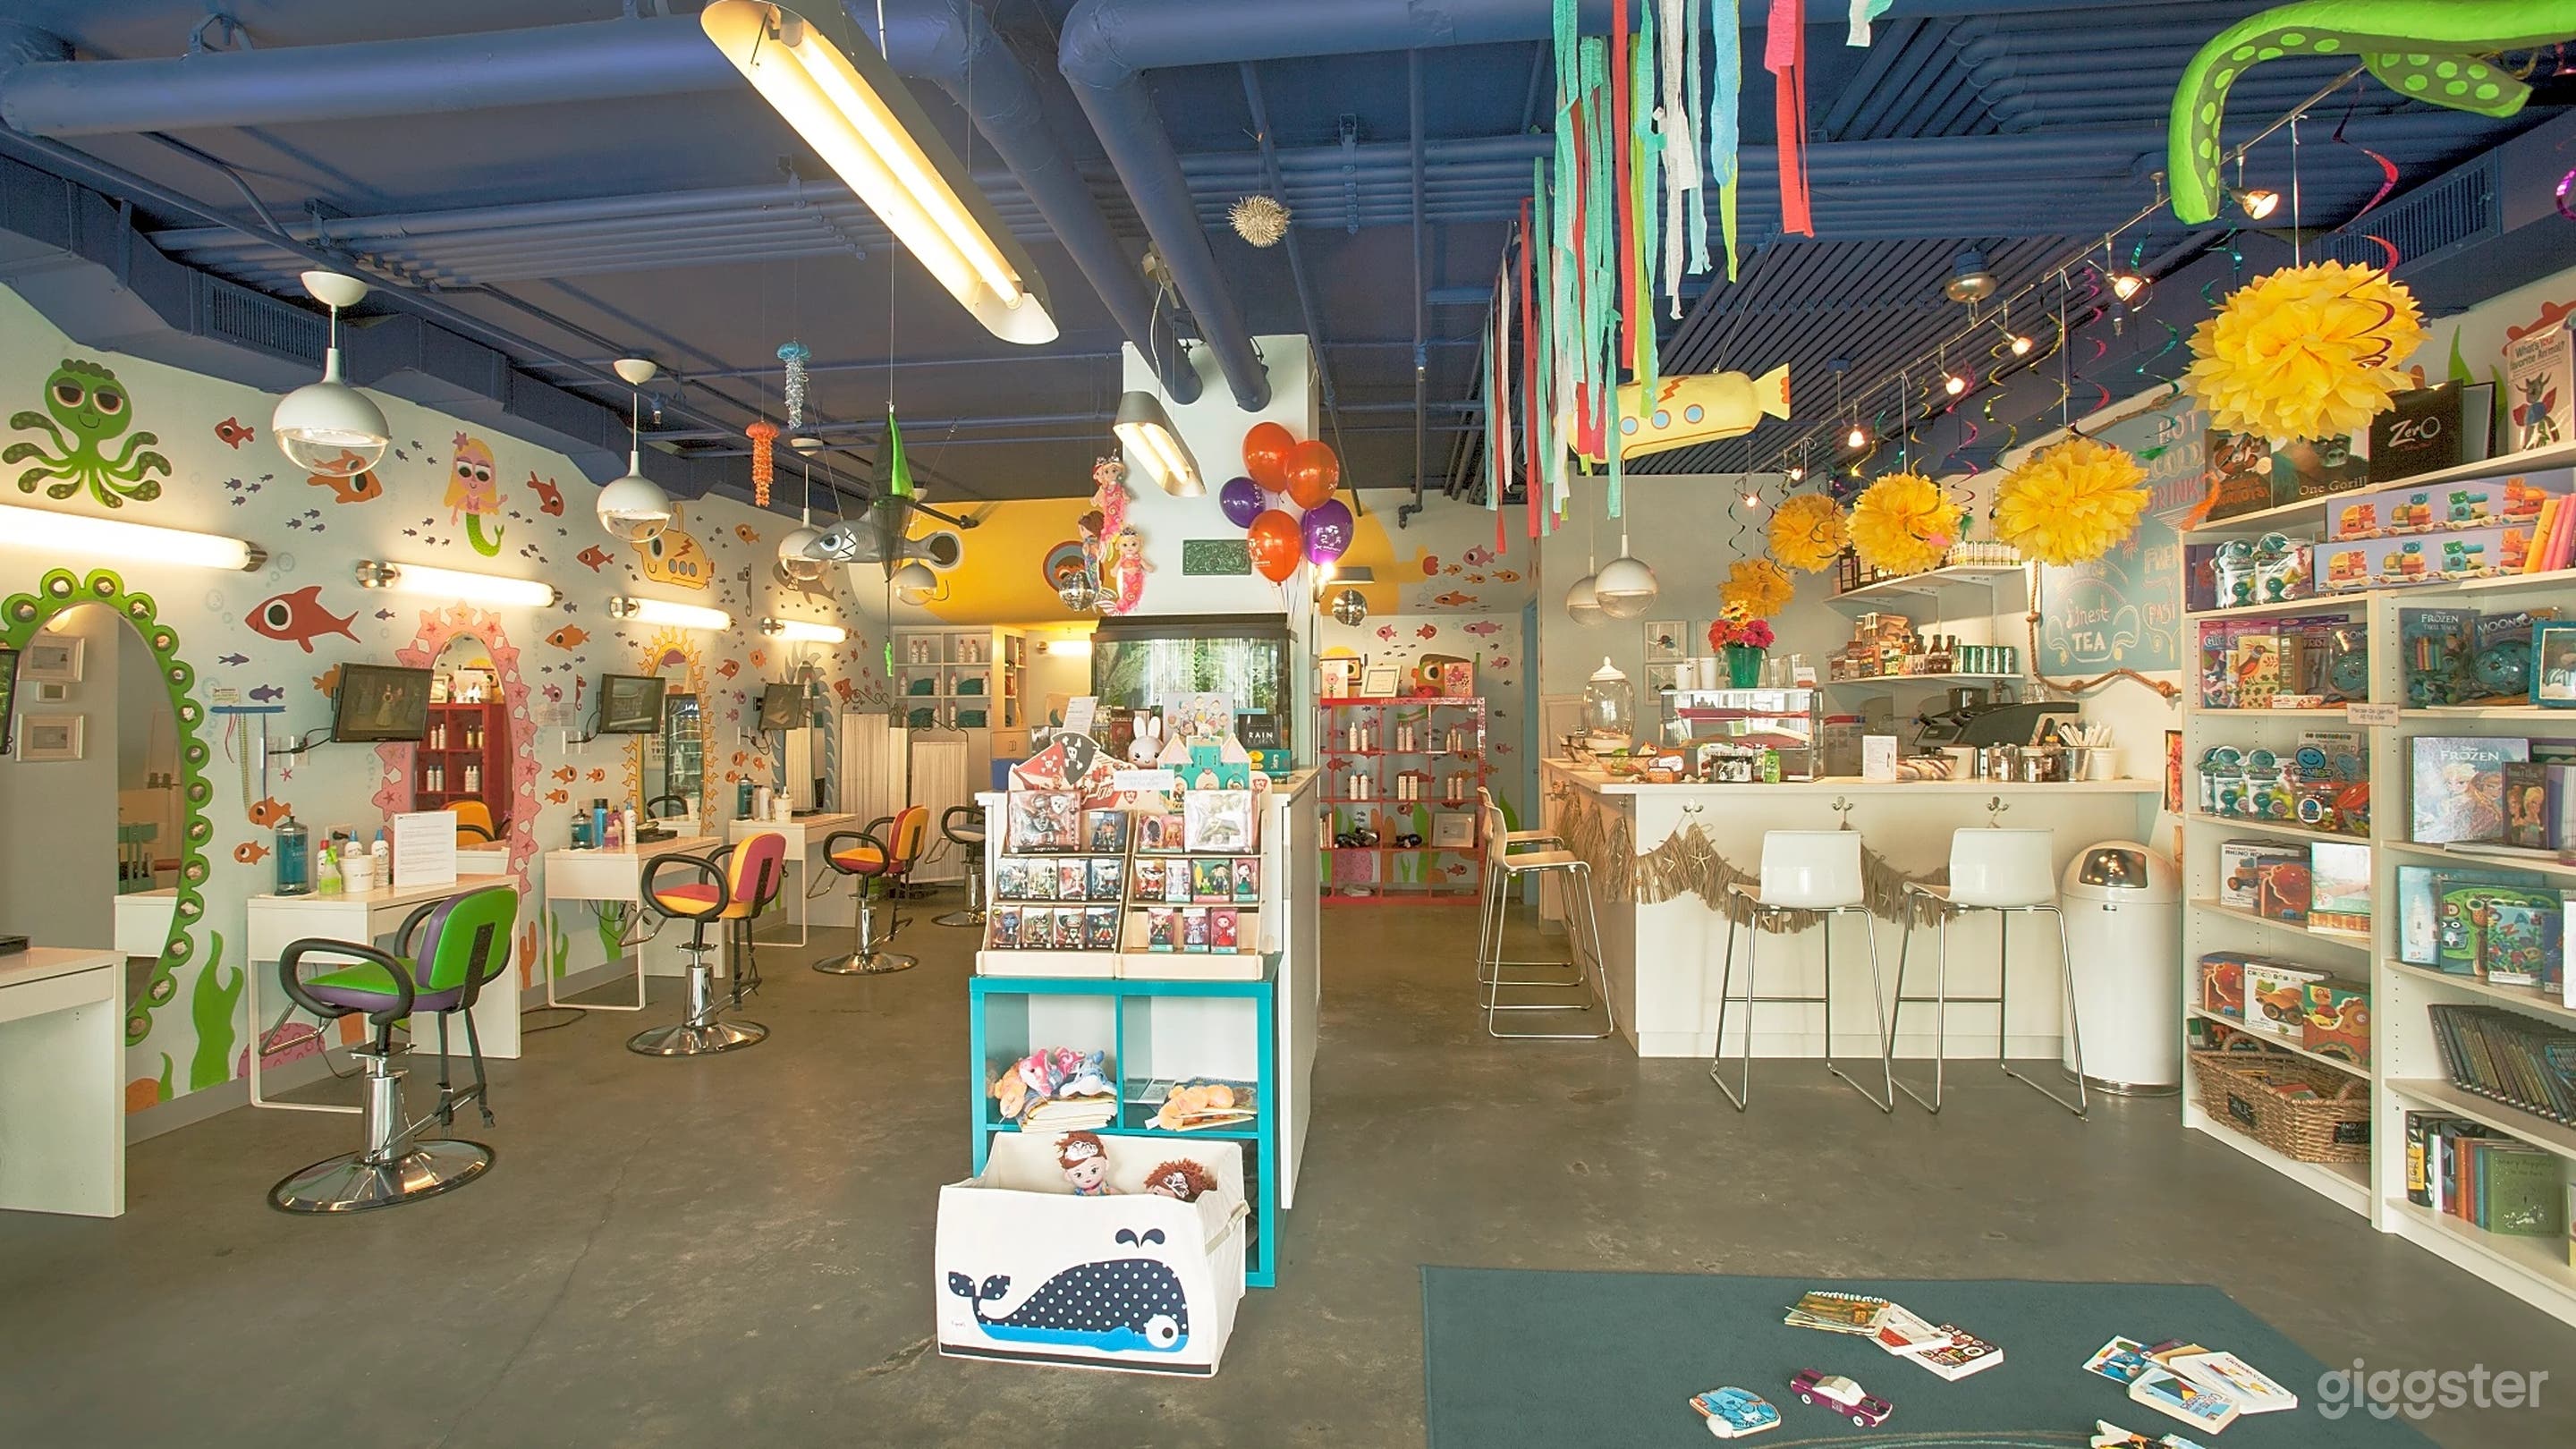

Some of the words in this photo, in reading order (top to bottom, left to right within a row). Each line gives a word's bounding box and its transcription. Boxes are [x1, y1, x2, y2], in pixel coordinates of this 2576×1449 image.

[2515, 341, 2539, 358] What's
[2538, 341, 2565, 359] Animal?
[2158, 410, 2198, 445] HOT
[2151, 442, 2205, 479] COLD
[2298, 484, 2326, 496] One
[2329, 475, 2368, 493] Gorill
[2148, 602, 2177, 626] PAST
[2420, 614, 2459, 623] FROZEN
[2071, 631, 2106, 653] TEA
[2440, 750, 2499, 763] FROZEN
